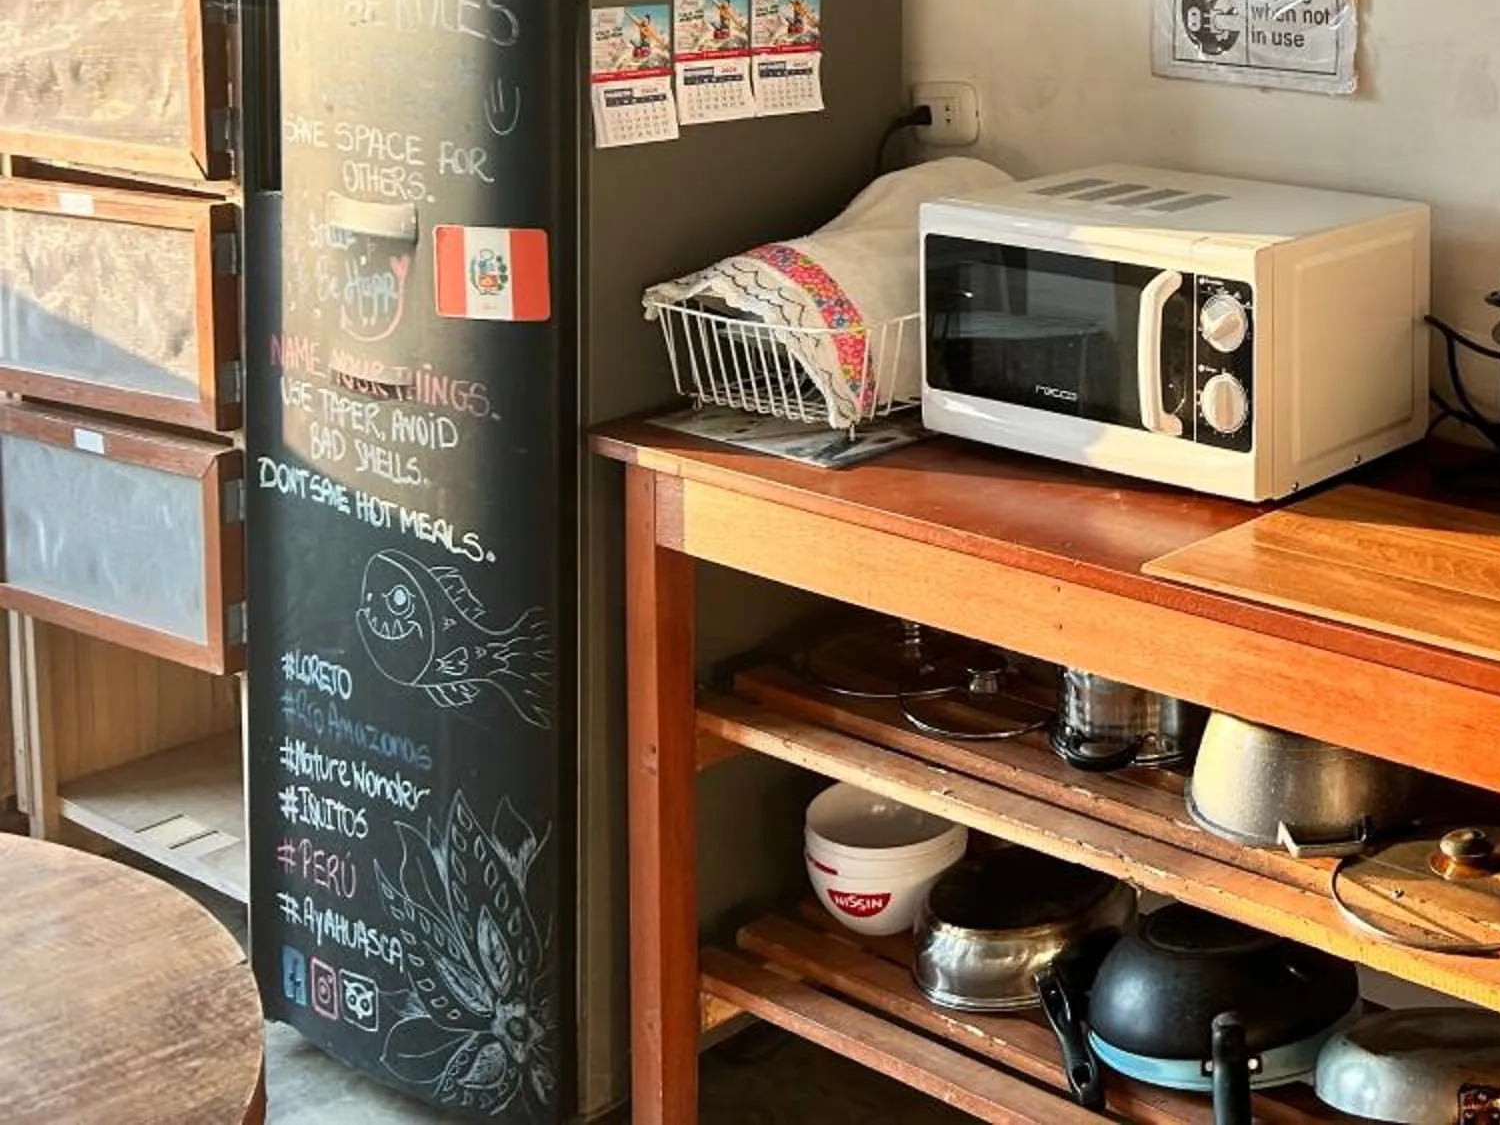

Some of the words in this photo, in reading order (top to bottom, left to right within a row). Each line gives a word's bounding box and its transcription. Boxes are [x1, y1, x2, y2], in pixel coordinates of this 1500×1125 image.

[1251, 25, 1267, 44] in
[1271, 29, 1305, 48] use
[1303, 8, 1331, 26] not
[335, 121, 426, 166] SPACE
[437, 139, 496, 183] FOR
[270, 334, 328, 378] NAME
[309, 422, 346, 462] BAD
[355, 490, 398, 528] HOT
[280, 648, 353, 700] #LORETO
[833, 895, 884, 912] NISSIN
